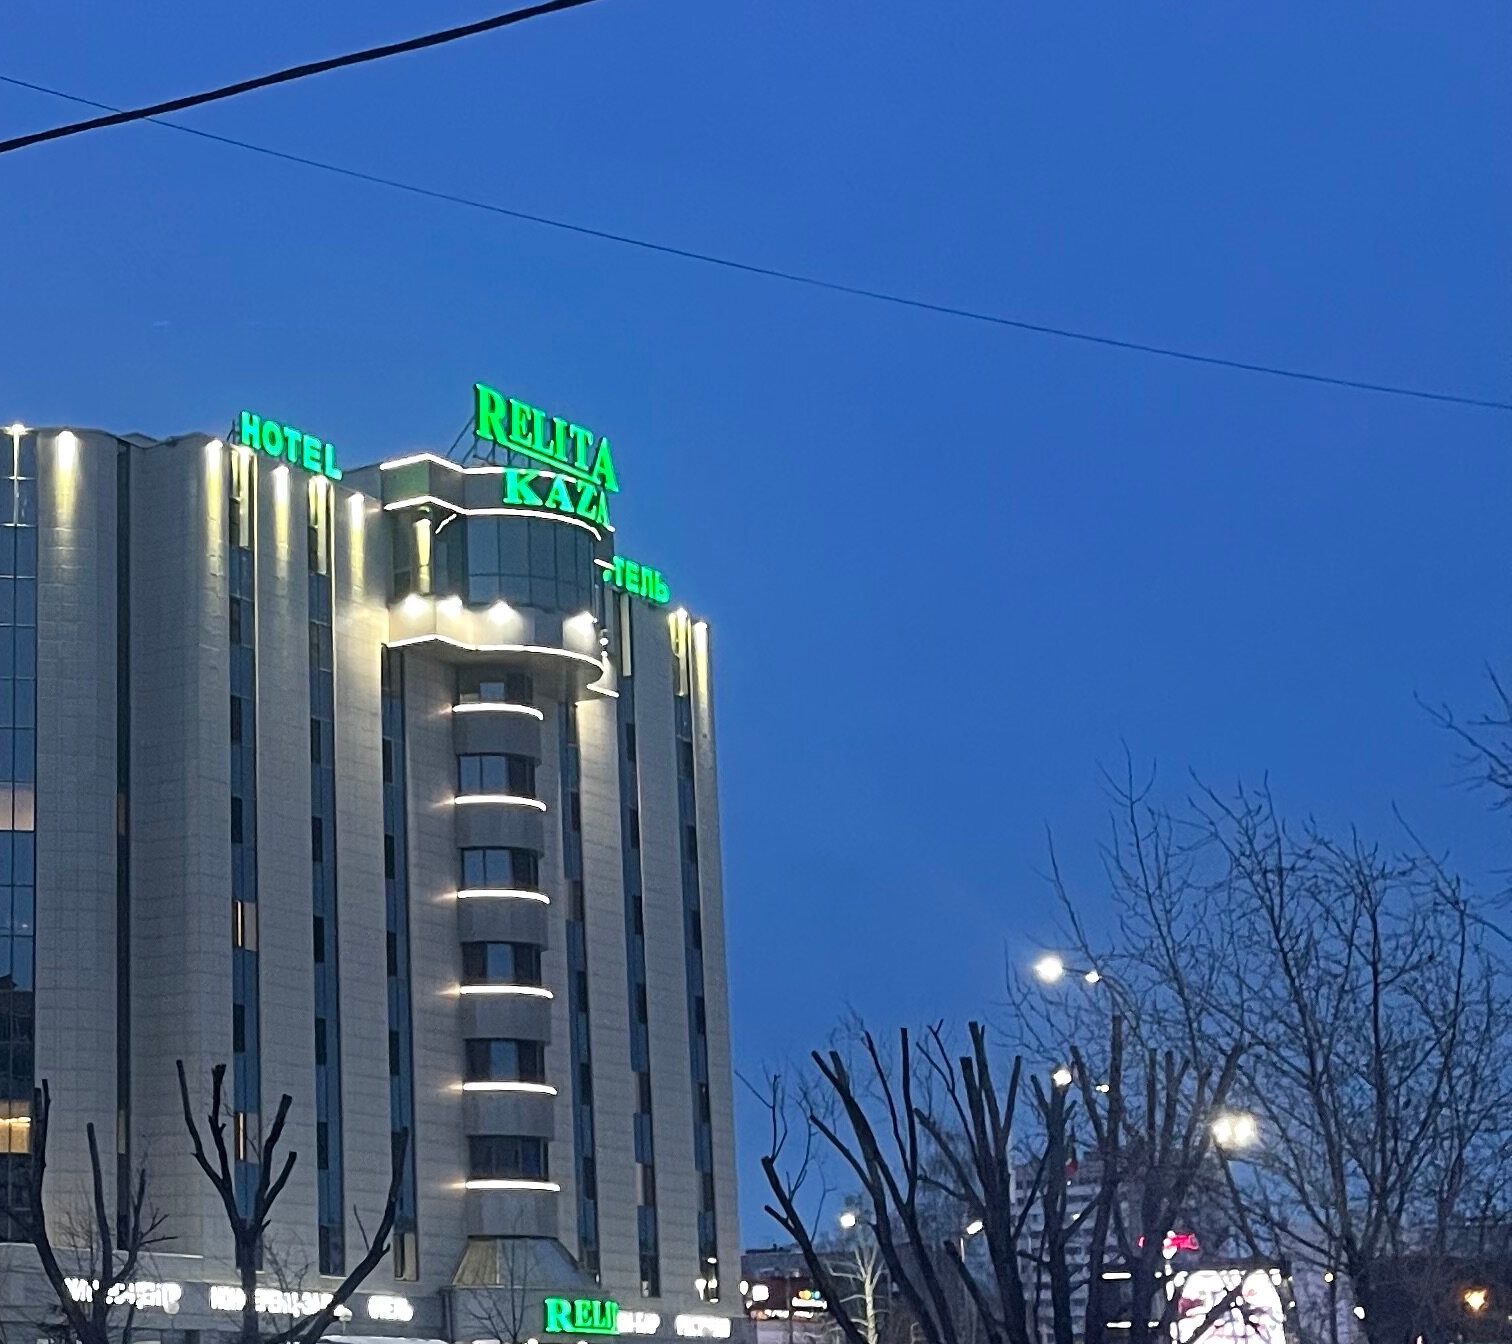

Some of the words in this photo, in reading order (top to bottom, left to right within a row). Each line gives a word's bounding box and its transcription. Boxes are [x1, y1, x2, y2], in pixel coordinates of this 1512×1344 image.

[241, 411, 342, 480] HOTEL
[475, 383, 619, 492] RELITA
[602, 555, 670, 604] ТЕЛЬ
